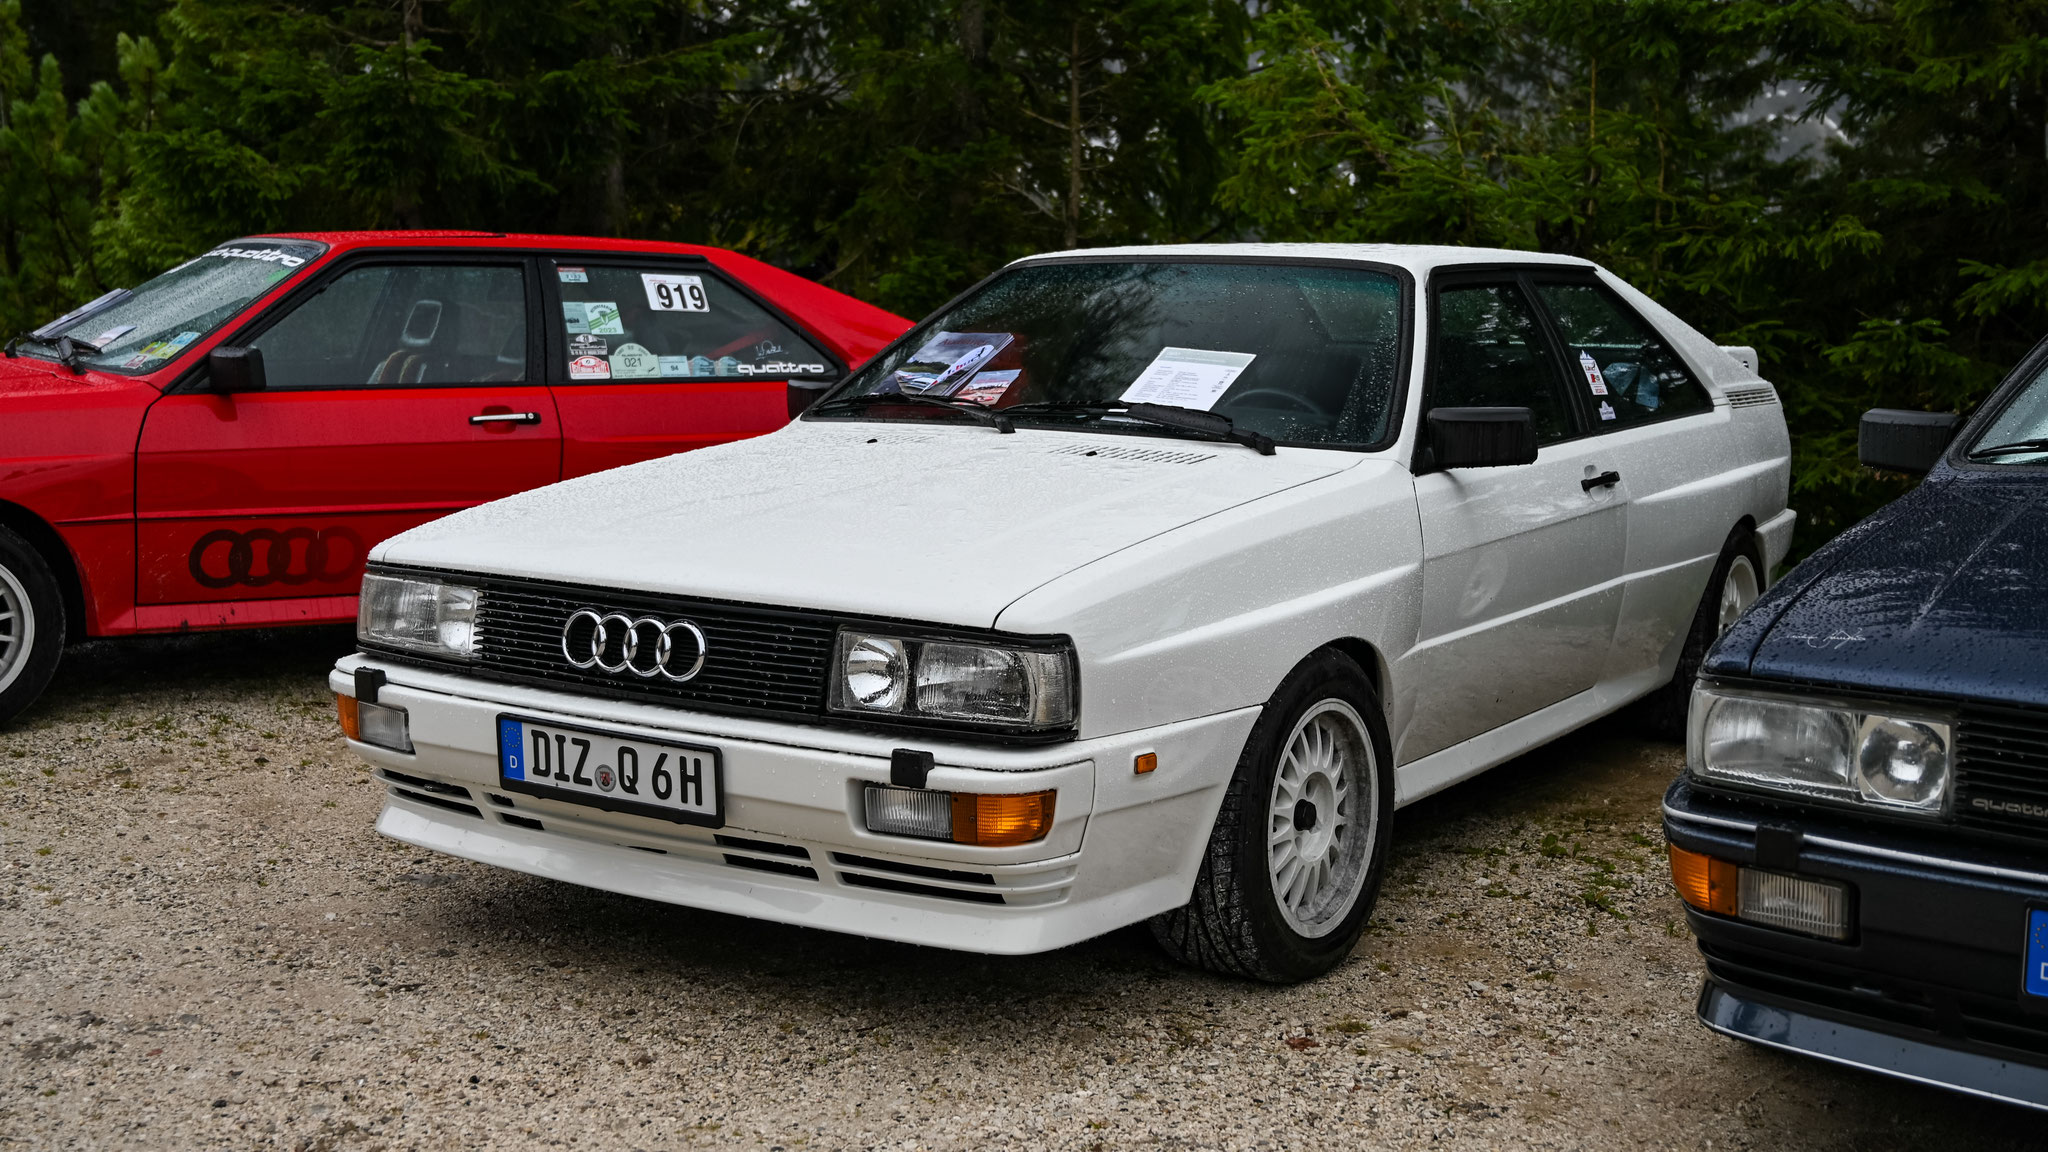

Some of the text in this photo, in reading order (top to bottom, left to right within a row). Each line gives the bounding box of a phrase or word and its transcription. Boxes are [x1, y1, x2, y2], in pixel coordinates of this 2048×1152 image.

[656, 283, 706, 310] 919
[623, 357, 642, 368] 021
[737, 362, 824, 376] quattro
[509, 755, 518, 769] D
[531, 729, 702, 806] DIZ Q 6H
